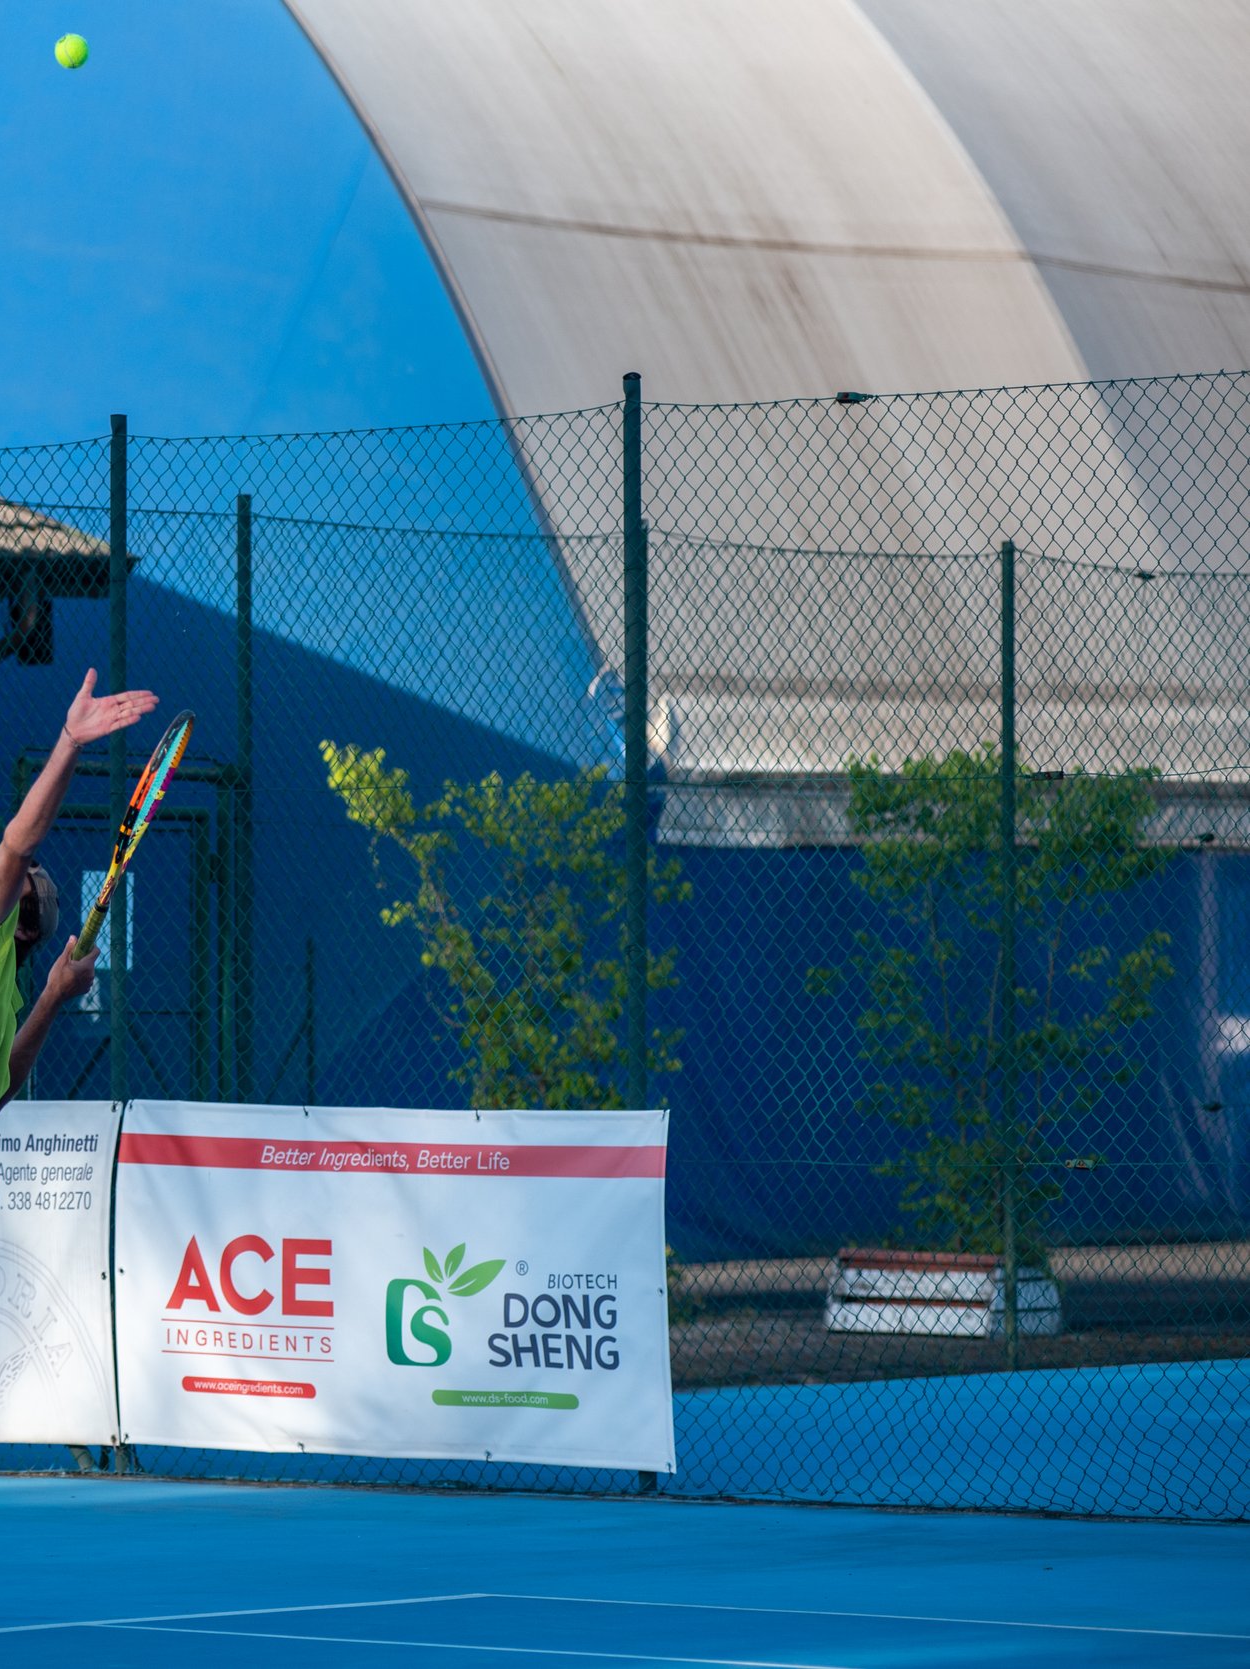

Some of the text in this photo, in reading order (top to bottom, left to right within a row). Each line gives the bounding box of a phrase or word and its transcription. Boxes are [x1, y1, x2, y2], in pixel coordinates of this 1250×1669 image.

[25, 1133, 99, 1156] Anghinetti
[261, 1145, 510, 1171] Better Ingredients, Better Life
[41, 1162, 93, 1185] generale
[8, 1191, 32, 1210] 338
[35, 1191, 92, 1210] 4812270
[165, 1234, 334, 1317] ACE
[548, 1273, 618, 1290] BIOTECH
[503, 1292, 617, 1330] DONG
[166, 1328, 332, 1354] INGREDIENTS
[488, 1333, 620, 1371] SHENG
[194, 1380, 304, 1395] www.aceingredients.com
[461, 1393, 549, 1405] www.ds-food.com
